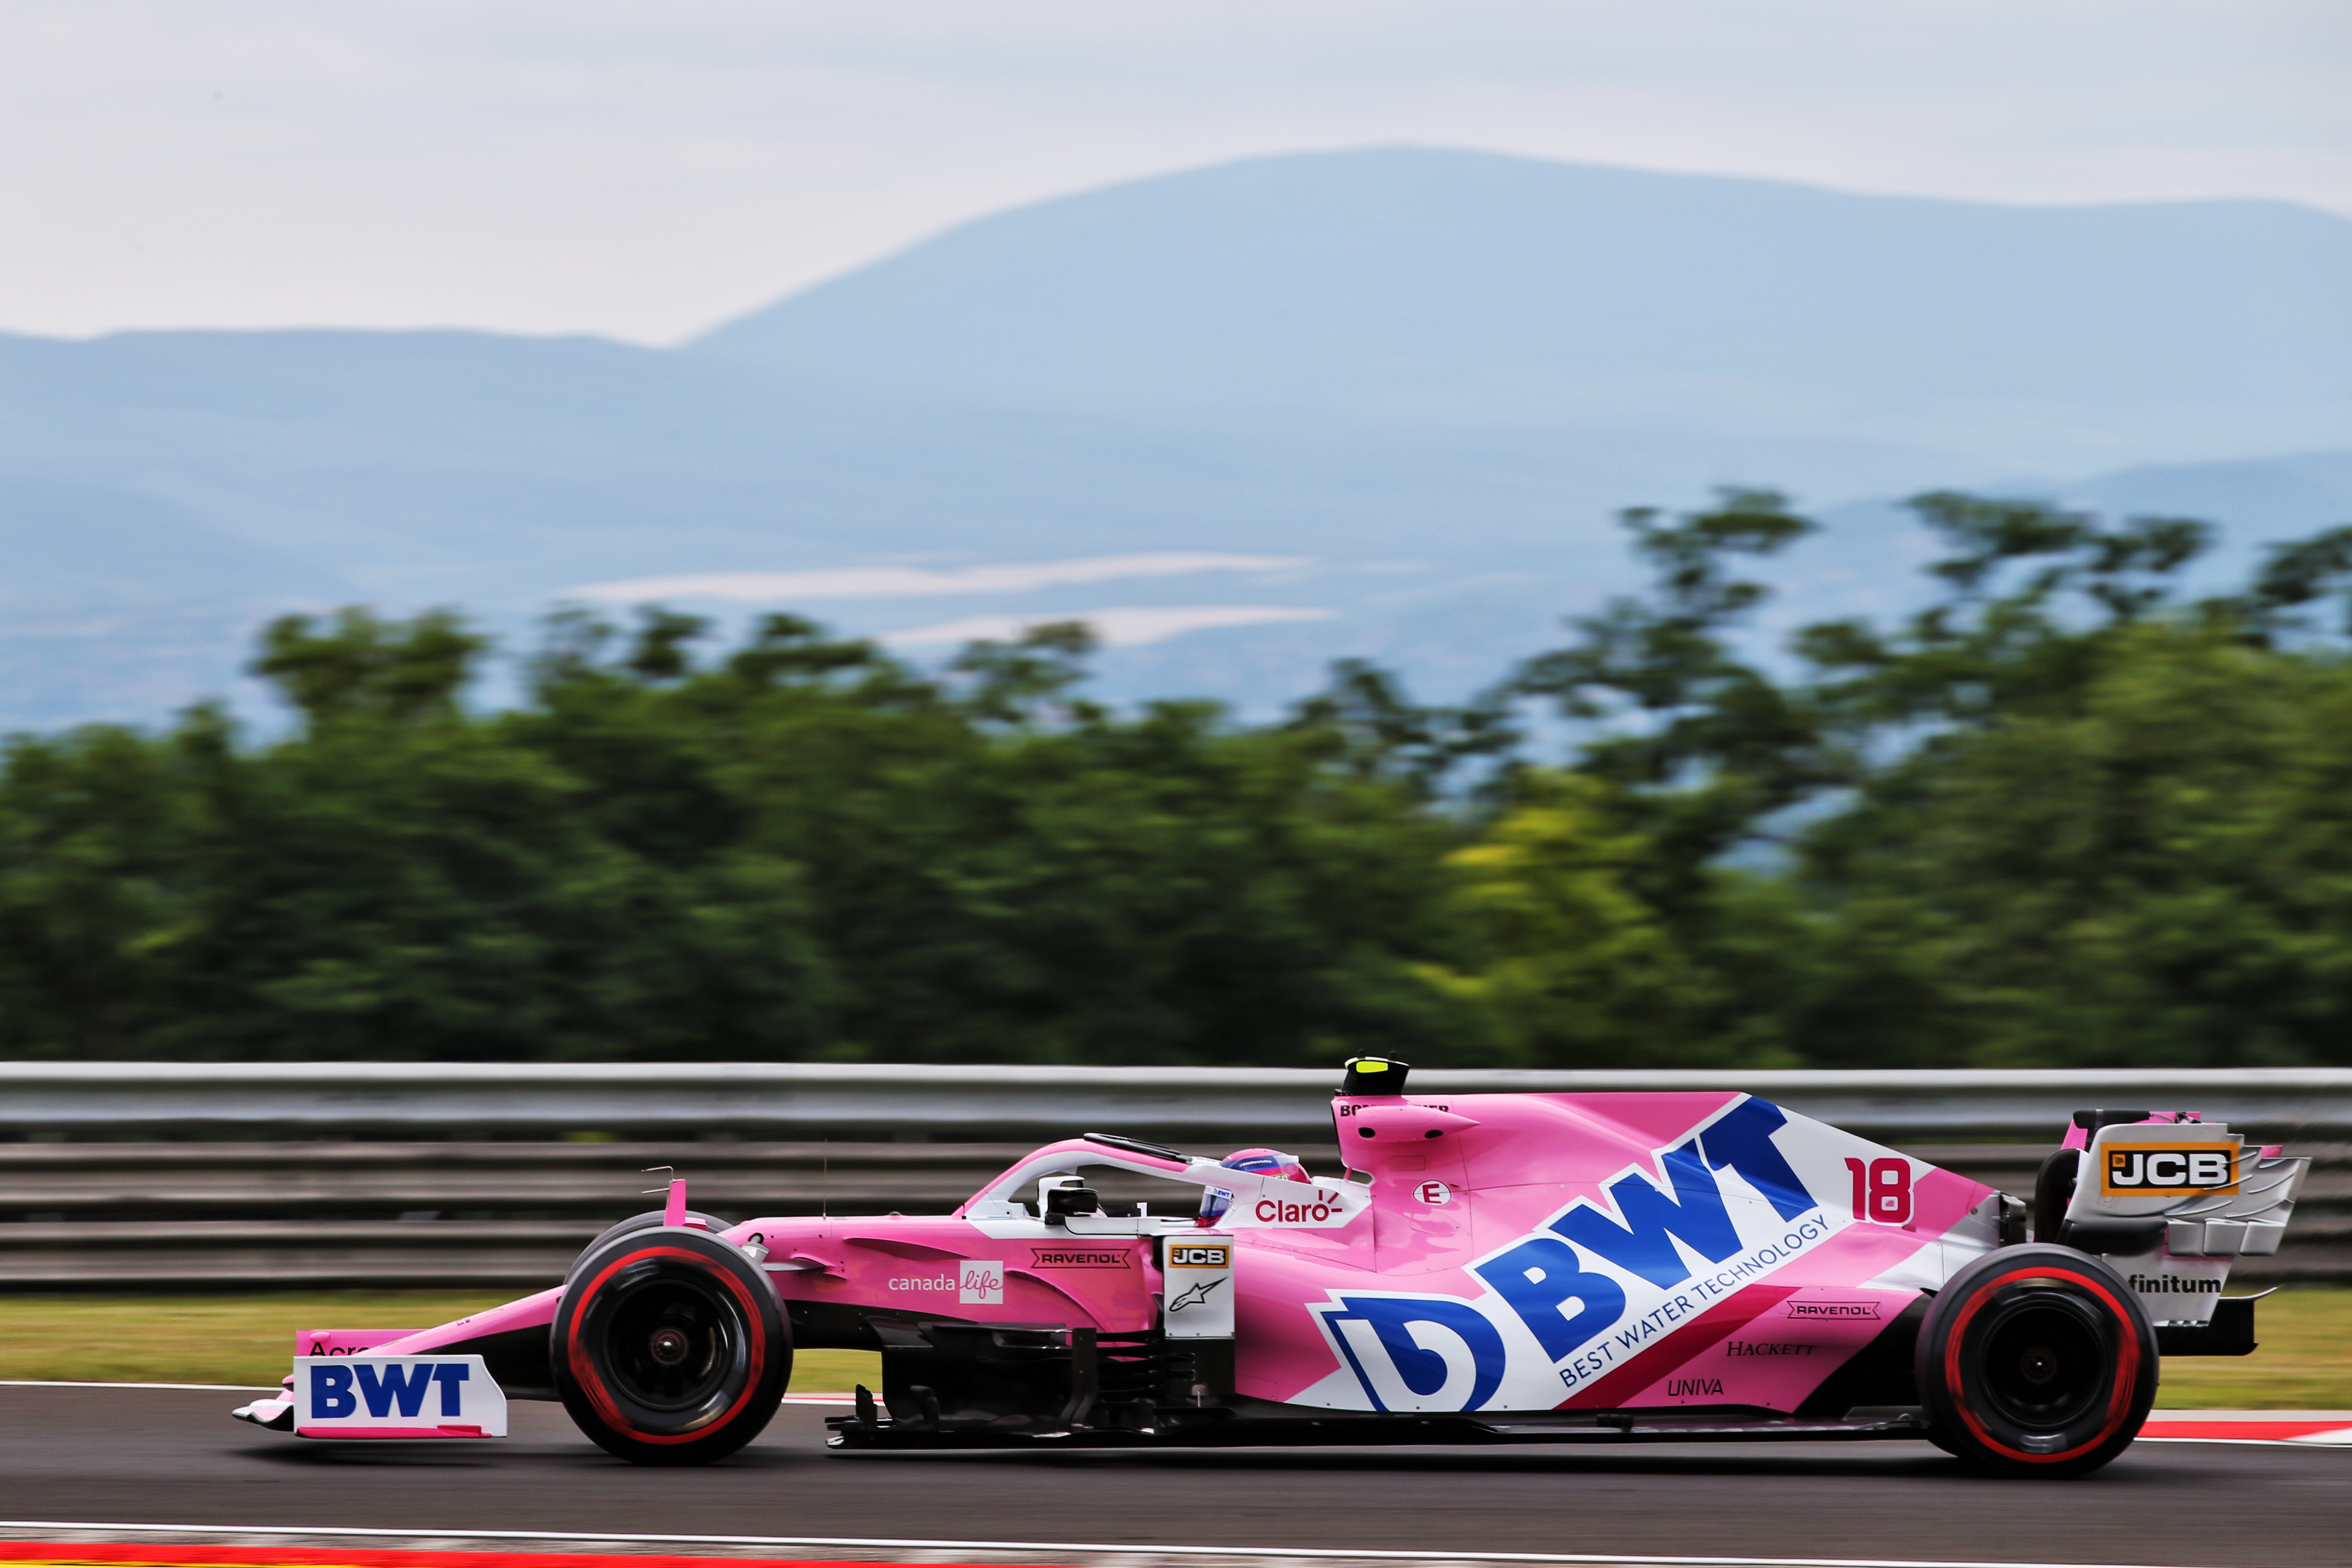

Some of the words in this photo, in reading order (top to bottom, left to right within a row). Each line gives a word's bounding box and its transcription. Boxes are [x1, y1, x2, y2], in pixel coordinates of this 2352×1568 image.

[2112, 1154, 2228, 1185] JCB
[1422, 1183, 1442, 1204] E
[1844, 1158, 1911, 1223] 18
[1255, 1200, 1329, 1222] Claro
[1474, 1096, 1819, 1362] BWT
[1042, 1254, 1120, 1263] RAVENOL
[1173, 1249, 1225, 1264] JCB
[888, 1273, 956, 1291] canada
[960, 1270, 1004, 1299] life
[1559, 1341, 1613, 1387] BEST
[1615, 1295, 1695, 1350] WATER
[1691, 1214, 1829, 1301] TECHNOLOGY
[1797, 1305, 1871, 1315] RAVENOL
[310, 1363, 469, 1419] BWT
[1668, 1378, 1724, 1396] UNIVA
